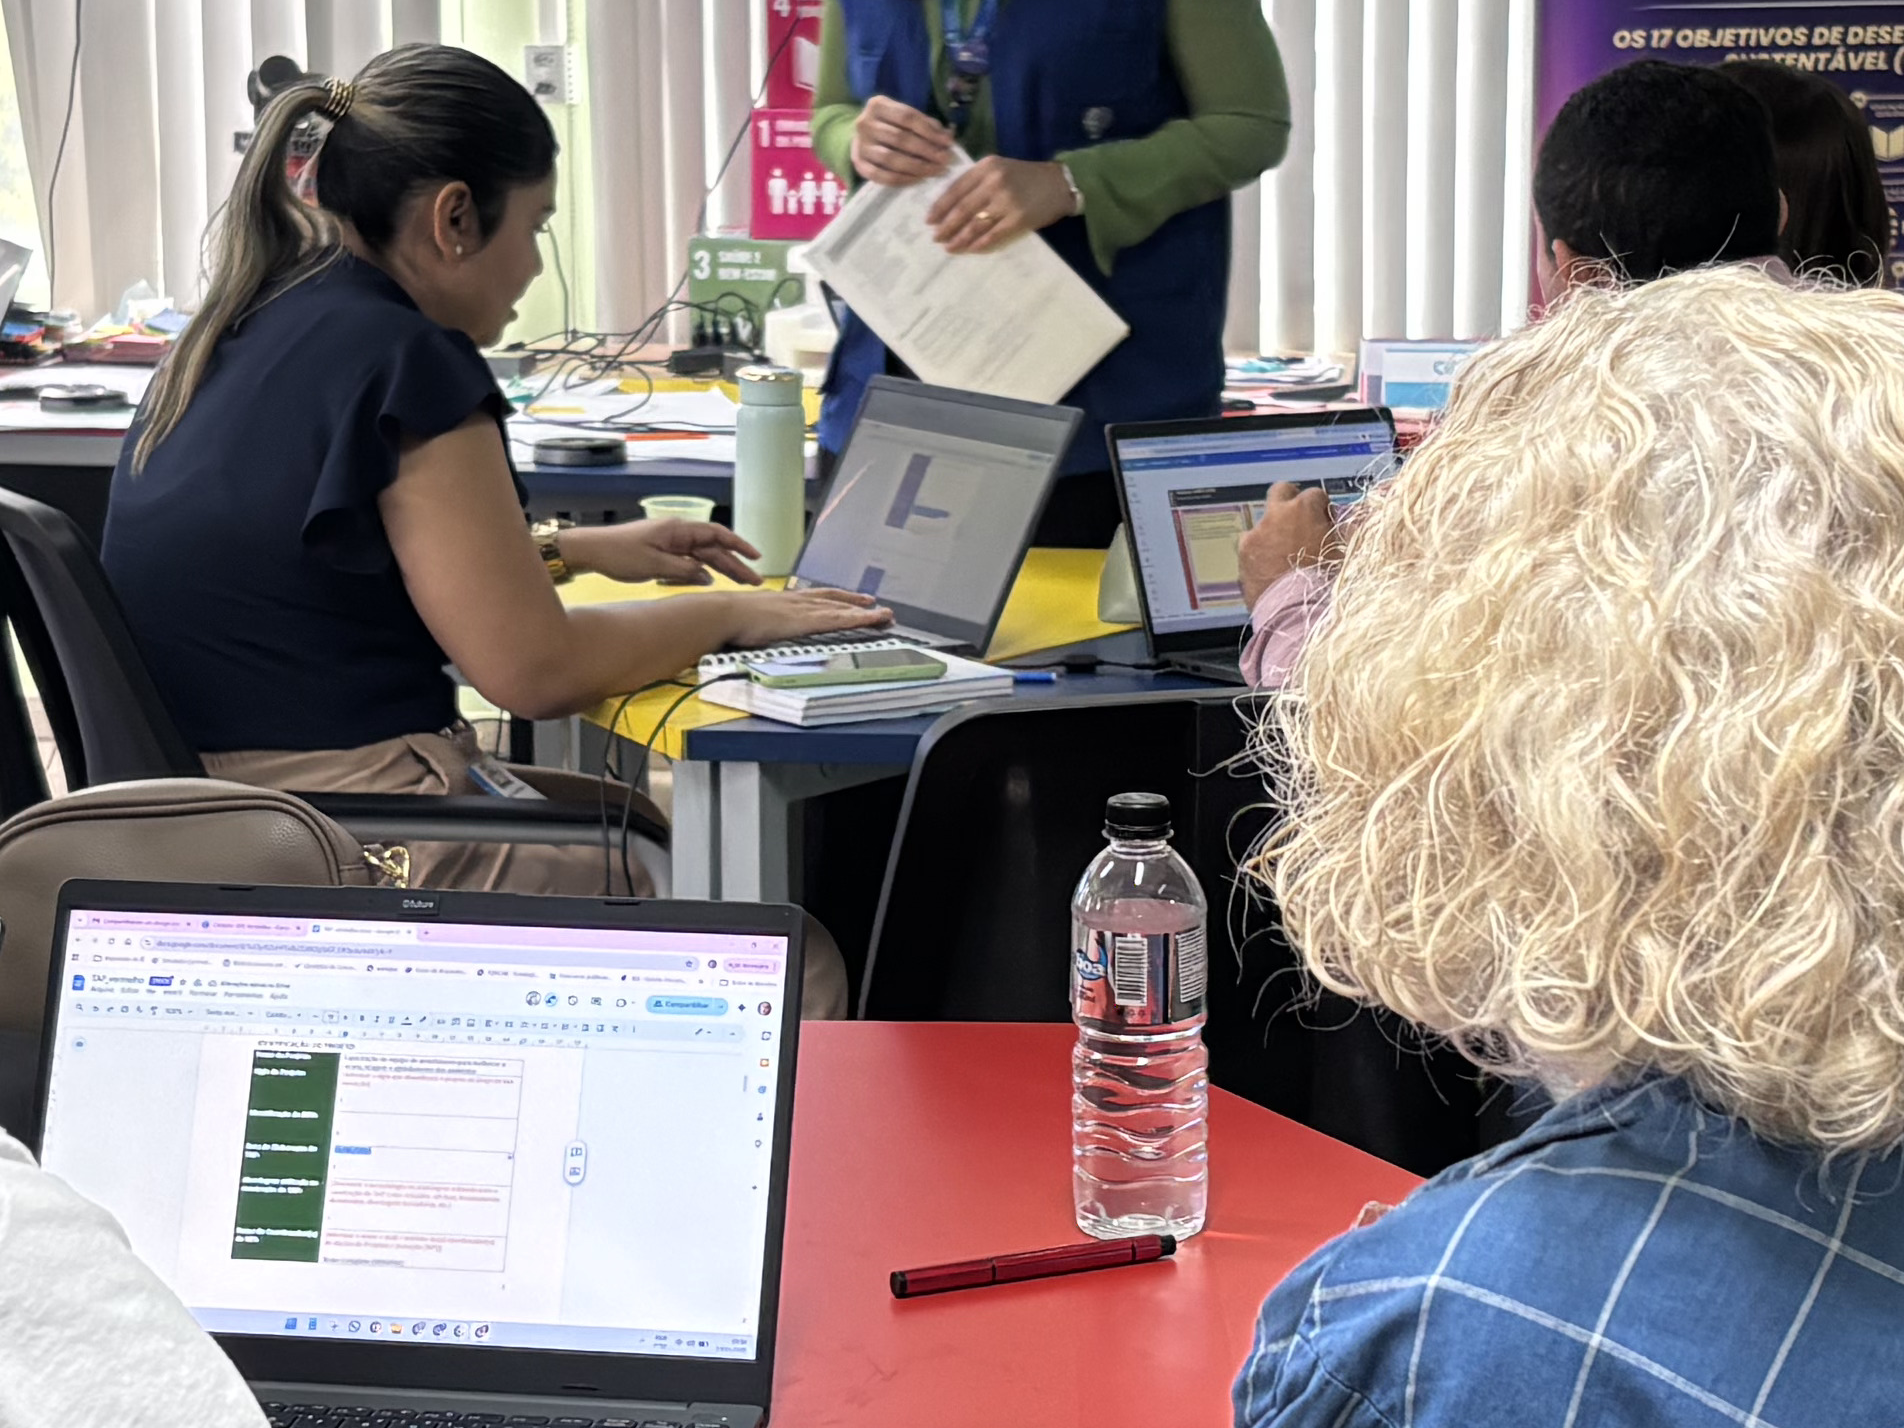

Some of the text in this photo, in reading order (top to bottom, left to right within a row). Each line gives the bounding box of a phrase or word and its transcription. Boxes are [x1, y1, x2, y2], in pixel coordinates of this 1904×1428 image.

[1612, 29, 1647, 49] OS
[1650, 28, 1674, 49] 17
[1676, 26, 1809, 49] OBJETIVOS
[1811, 26, 1845, 47] DE
[758, 120, 771, 148] 1
[694, 250, 711, 281] 3
